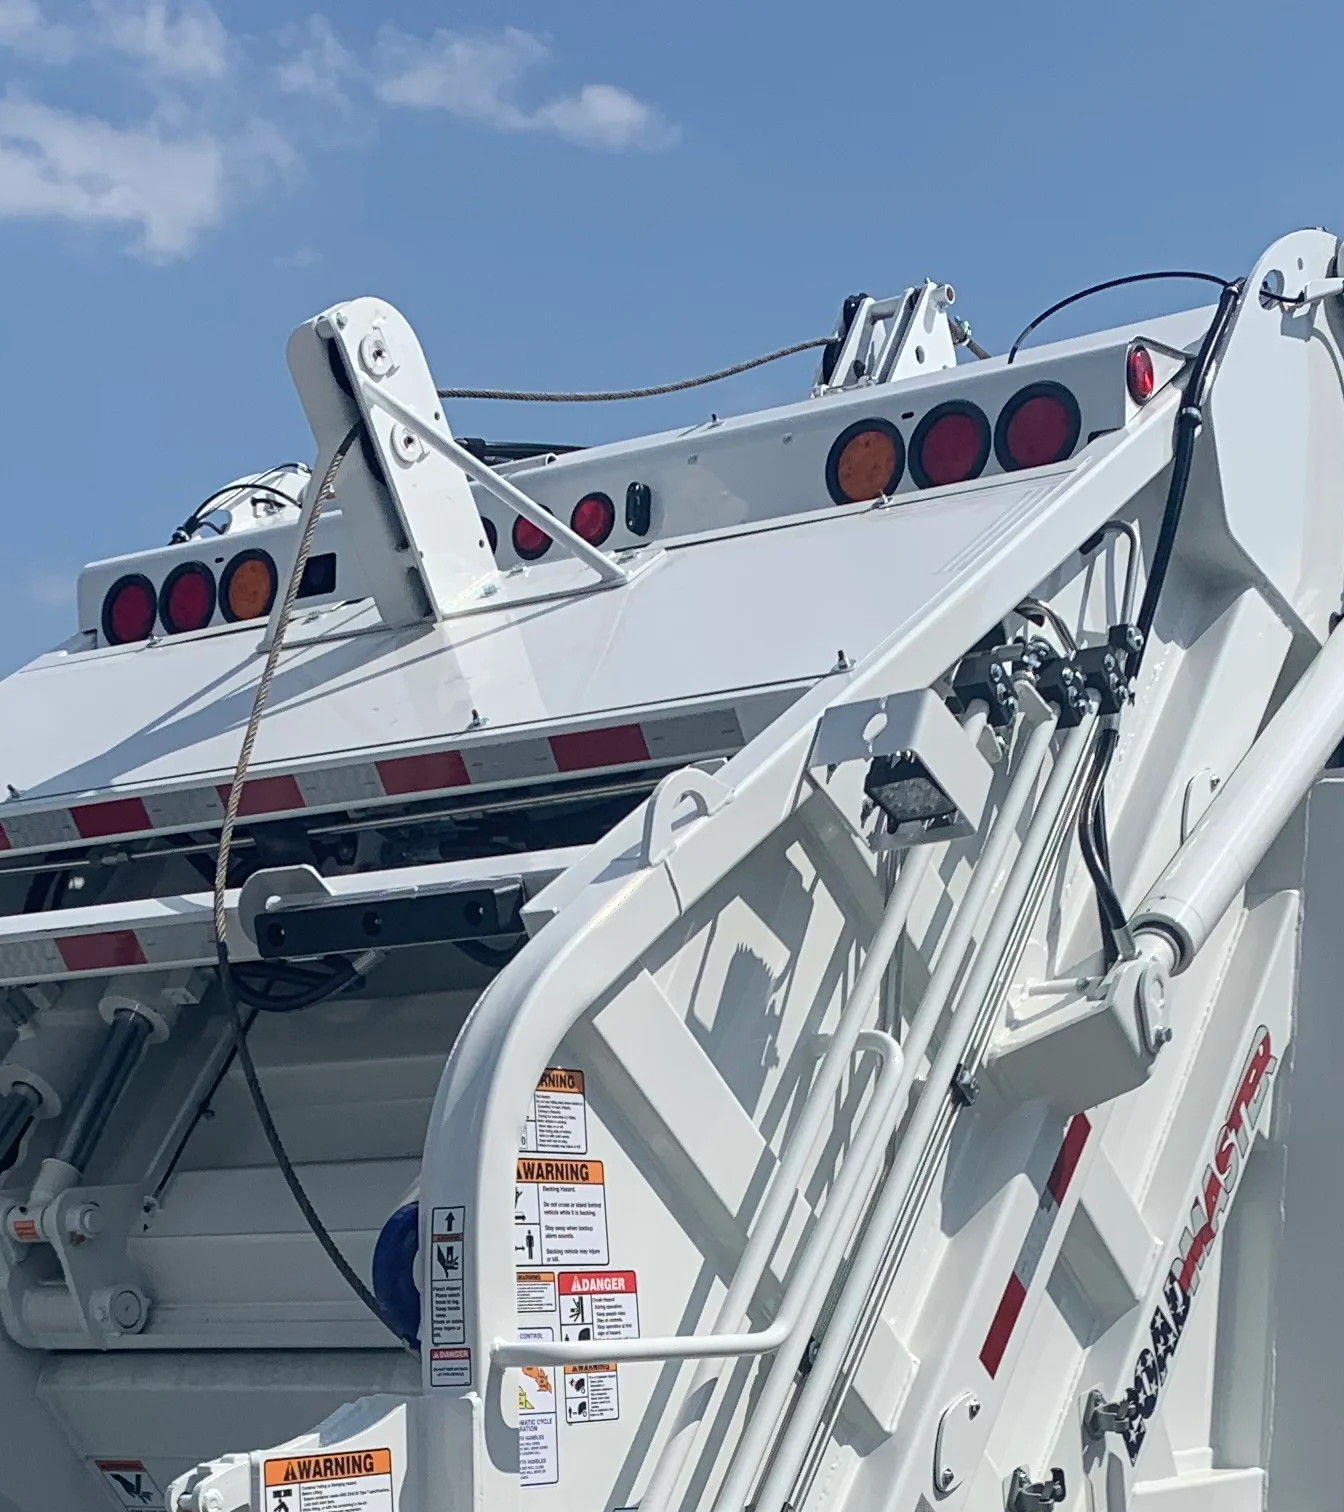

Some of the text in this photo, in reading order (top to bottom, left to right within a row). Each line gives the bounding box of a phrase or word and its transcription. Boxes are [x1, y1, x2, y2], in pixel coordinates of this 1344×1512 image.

[536, 1072, 576, 1089] RNING
[522, 1162, 589, 1181] WARNING
[582, 1278, 625, 1291] DANGER
[297, 1454, 374, 1480] WARNING
